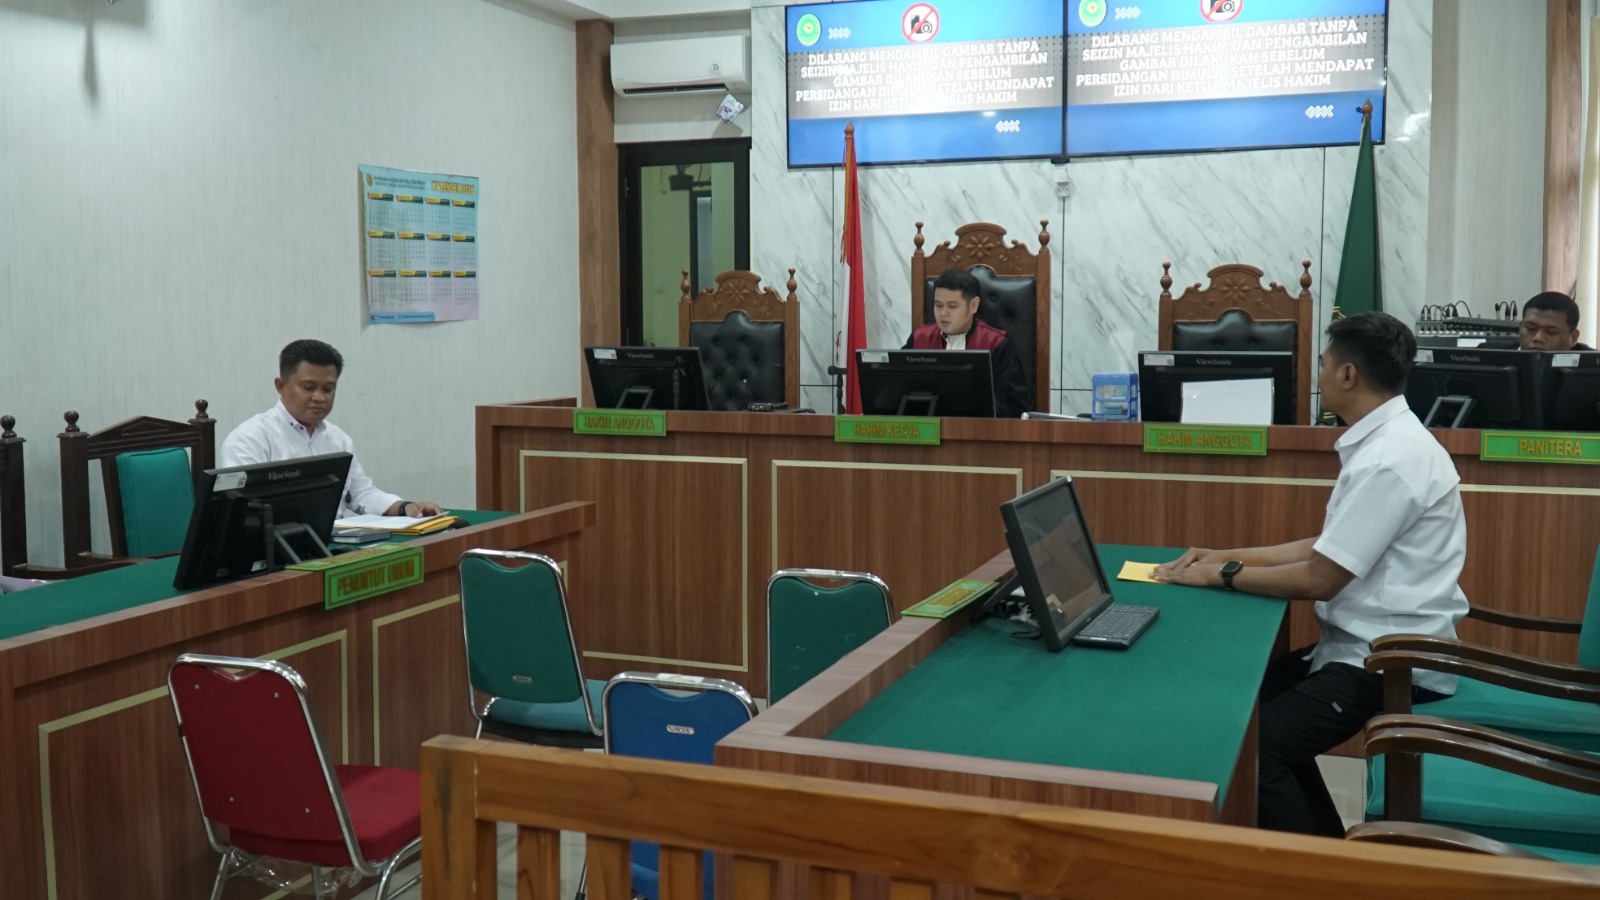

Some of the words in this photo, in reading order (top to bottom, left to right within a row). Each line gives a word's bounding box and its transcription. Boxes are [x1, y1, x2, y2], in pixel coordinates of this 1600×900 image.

[1092, 32, 1159, 48] DILARANG
[1161, 27, 1243, 43] MENGAMBIL
[1247, 23, 1307, 37] GAMBAR
[1309, 20, 1358, 33] TANPA
[809, 51, 867, 65] DILARANG
[869, 47, 940, 62] MENGAMBIL
[943, 43, 995, 57] GAMBAR
[996, 40, 1040, 55] TANPA
[1082, 47, 1123, 61] SEIZIN
[1125, 43, 1181, 58] MAJELIS
[1184, 41, 1229, 54] HAKIM
[1232, 38, 1262, 51] DAN
[1264, 32, 1367, 49] PENGAMBILAN
[801, 65, 837, 78] SEIZIN
[837, 62, 886, 75] AJELIS
[888, 59, 931, 72] HAKIM
[931, 57, 956, 70] DAN
[959, 52, 1048, 69] PENGAMBILAN
[1120, 57, 1177, 71] GAMBAR
[1180, 51, 1259, 68] DILAKUKAN
[1262, 48, 1326, 62] SEBELUM
[833, 74, 884, 87] GAMBAR
[956, 66, 1012, 80] SEBELUM
[1076, 70, 1168, 86] PERSIDANGAN
[1171, 66, 1227, 81] DIMULAI
[1231, 62, 1292, 77] SETELAH
[1294, 58, 1375, 73] MENDAPAT
[796, 86, 876, 101] PERSIDANGAN
[930, 80, 982, 95] SETELAH
[985, 76, 1054, 91] MENDAPAT
[1113, 84, 1141, 97] IZIN
[1142, 82, 1174, 96] DARI
[1177, 79, 1221, 94] KETUA
[1224, 76, 1281, 91] MAJELIS
[1284, 73, 1332, 88] HAKIM
[828, 99, 851, 112] IZIN
[853, 98, 881, 111] DARI
[976, 90, 1018, 104] HAKIM
[1196, 358, 1233, 366] ViewSonic
[1450, 354, 1481, 363] ViewSonic
[853, 423, 884, 437] HAKIM
[1157, 432, 1193, 446] HAKIM
[1196, 432, 1252, 448] ANGGOTA
[1519, 439, 1583, 457] PANITERA
[268, 469, 302, 480] ViewSonic
